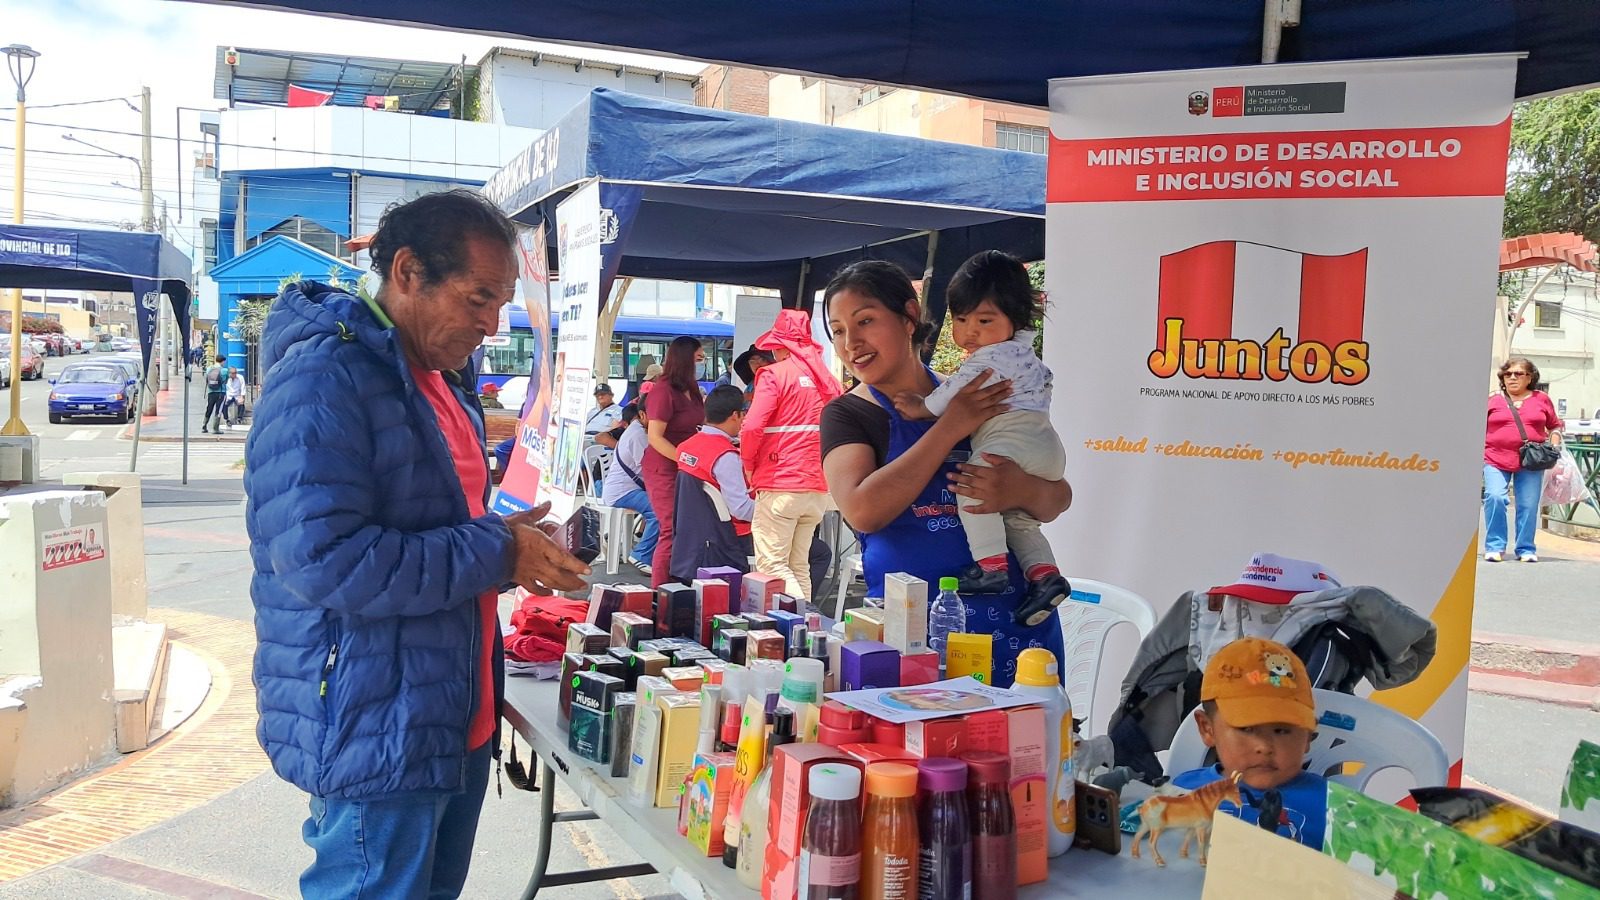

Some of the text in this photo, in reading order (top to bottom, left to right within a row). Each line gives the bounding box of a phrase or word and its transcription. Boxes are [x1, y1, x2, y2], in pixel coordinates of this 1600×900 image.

[1216, 95, 1239, 107] PERÚ
[1247, 88, 1286, 97] Ministerio
[1247, 96, 1298, 105] de Desarrollo
[1253, 103, 1287, 113] Inclusión
[1288, 103, 1311, 112] Social
[1087, 138, 1462, 167] MINISTERIO DE DESARROLLO
[1135, 166, 1399, 192] E INCLUSIÓN SOCIAL
[0, 238, 71, 256] OVINCIAL DE ILO
[1147, 317, 1370, 386] Juntos
[1140, 387, 1375, 406] PROGRAMA NACIONAL DE APOYO DIRECTO A LOS MÁS POBRES
[1084, 435, 1441, 473] +salud +educación +oportunidades
